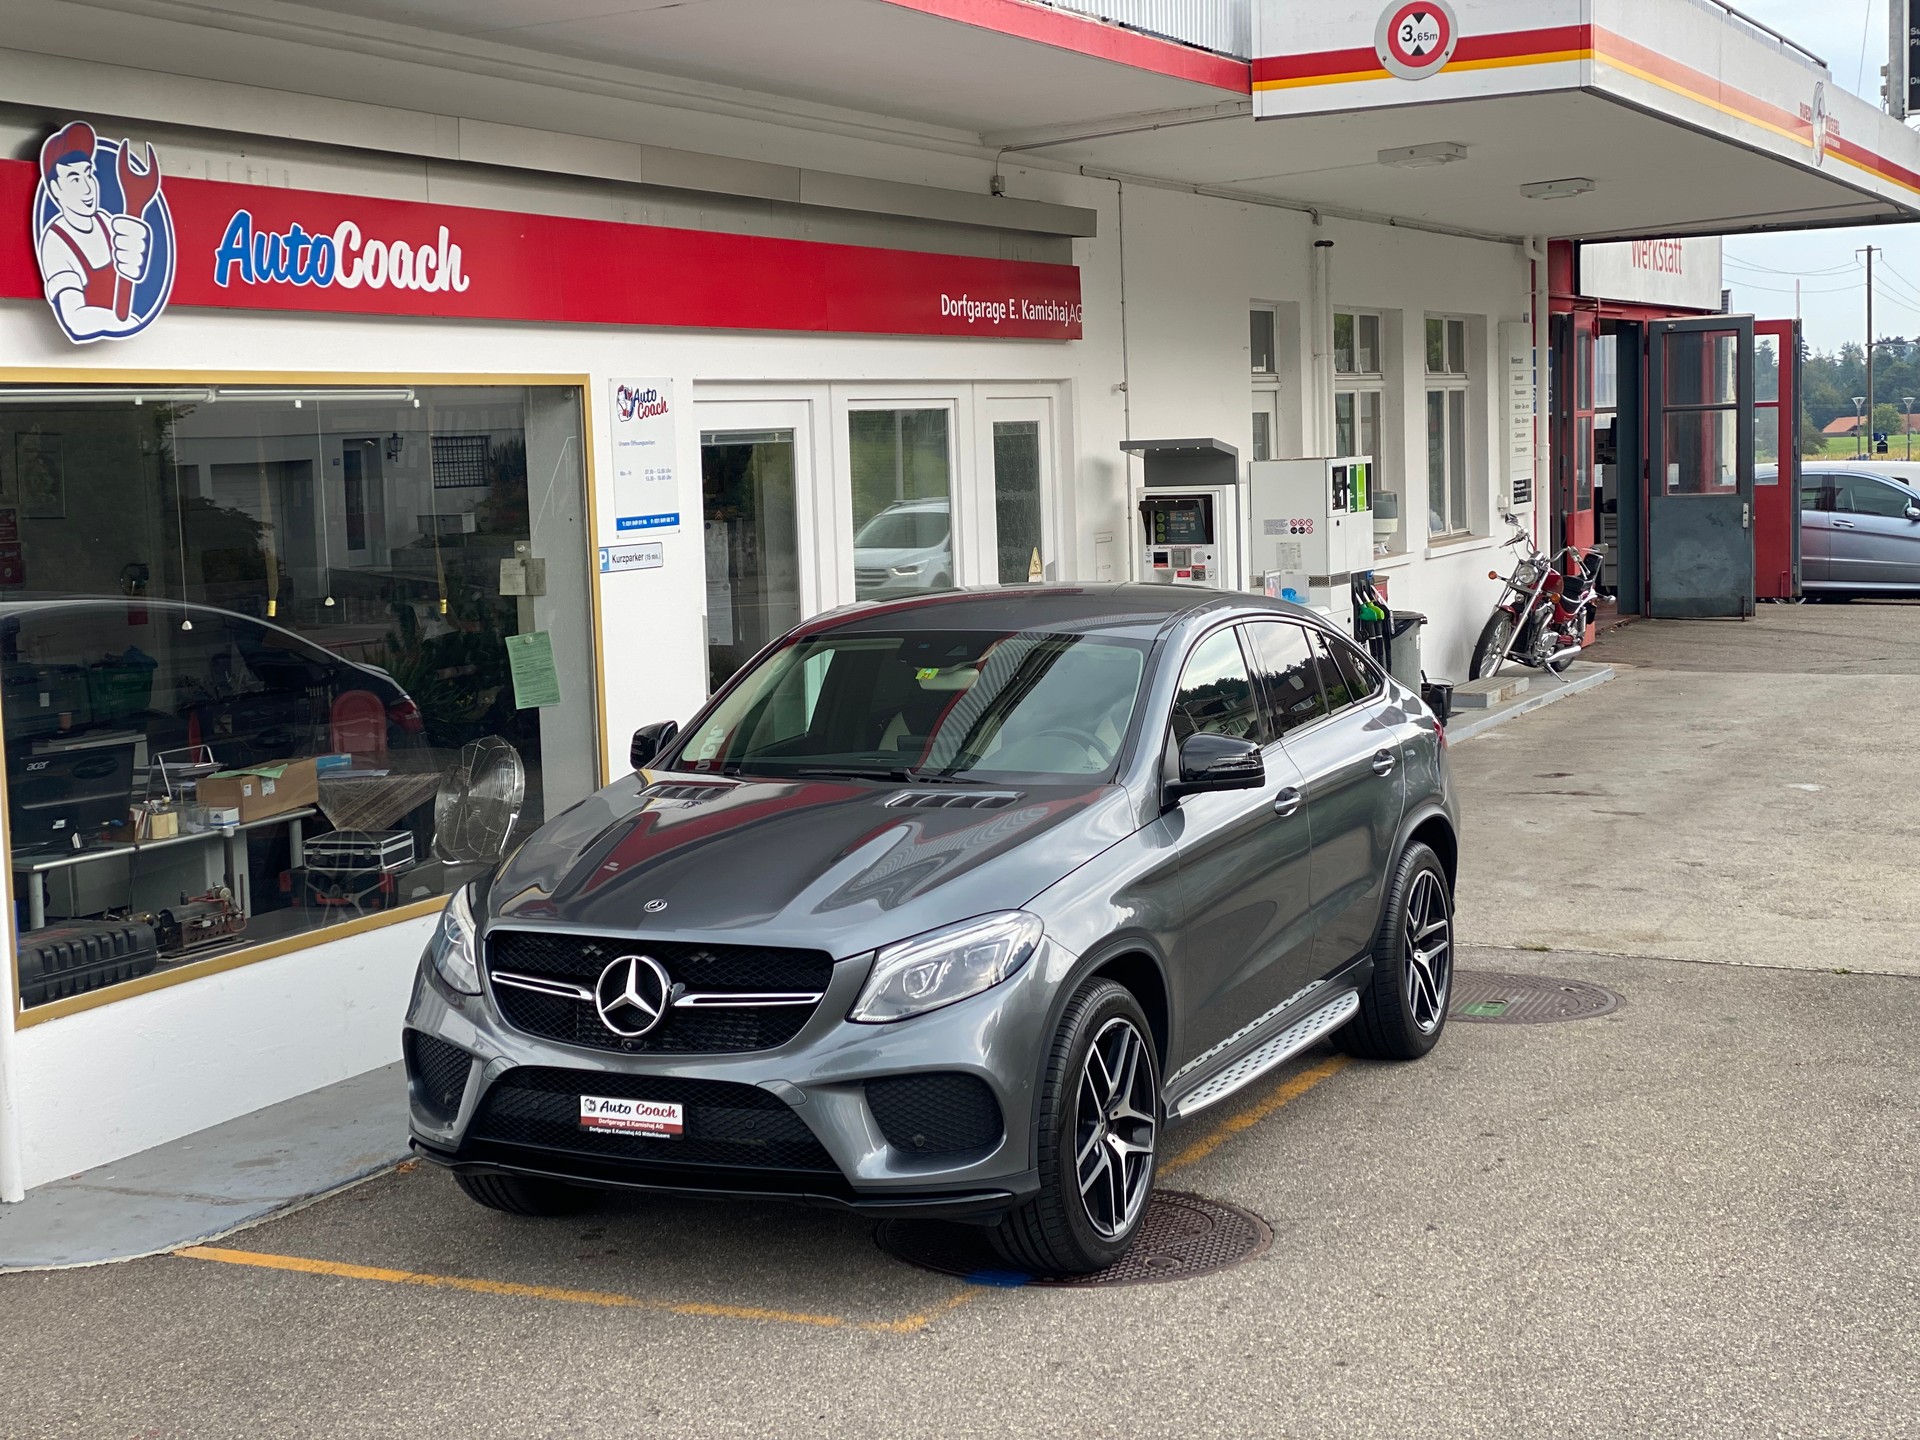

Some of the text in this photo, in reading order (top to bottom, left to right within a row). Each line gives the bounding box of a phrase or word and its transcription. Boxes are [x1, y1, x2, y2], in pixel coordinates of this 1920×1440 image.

[1631, 238, 1682, 275] Werkstatt
[940, 293, 1006, 325] Dorfgarage
[1008, 298, 1019, 319] E.
[633, 388, 657, 407] Auto
[637, 396, 669, 419] Coach
[611, 552, 644, 564] Kurzparker
[26, 760, 50, 771] acer
[600, 1100, 678, 1119] Auto Coach
[598, 1118, 626, 1127] Dorfgarage
